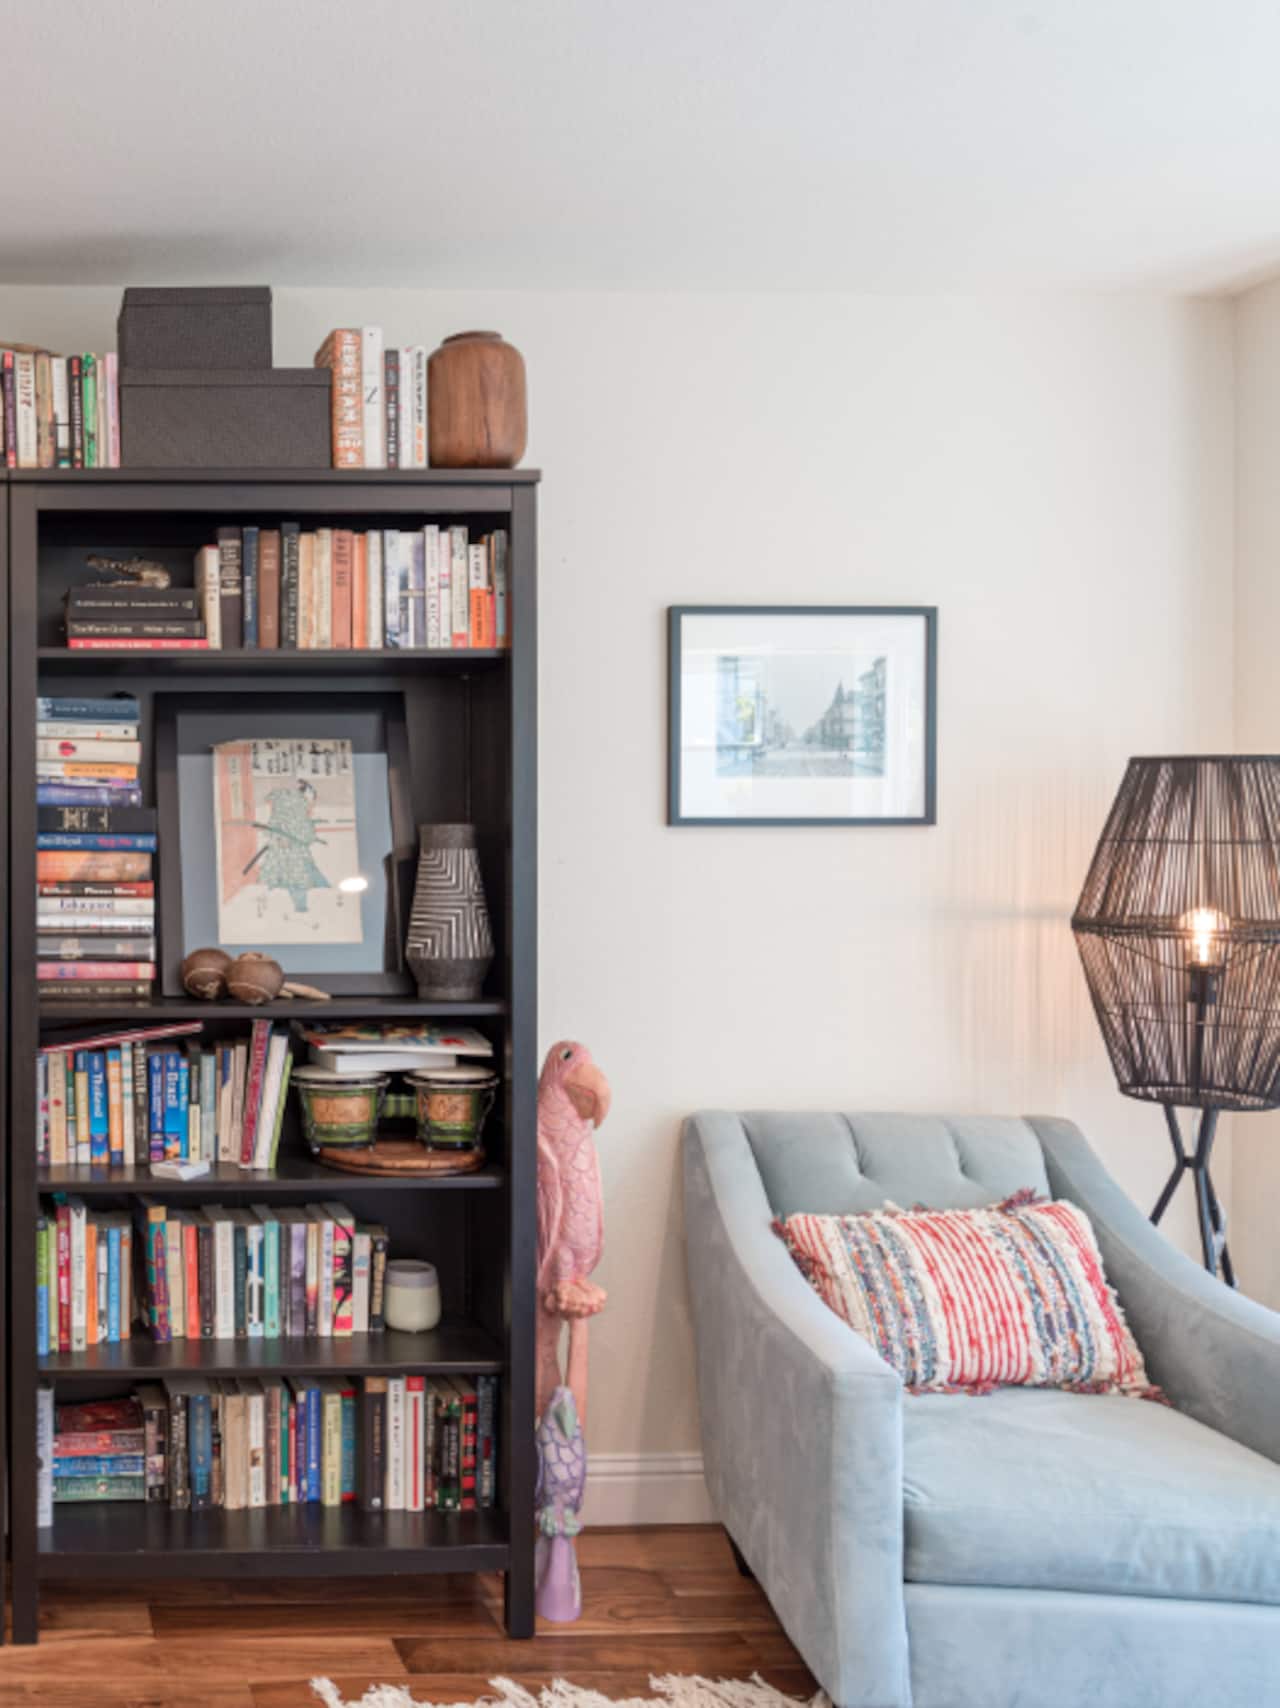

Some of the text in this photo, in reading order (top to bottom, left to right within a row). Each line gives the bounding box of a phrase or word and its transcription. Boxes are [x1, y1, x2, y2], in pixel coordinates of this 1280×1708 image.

[341, 333, 356, 374] HERE
[93, 1072, 104, 1118] Thailand
[167, 1071, 178, 1108] Brazil
